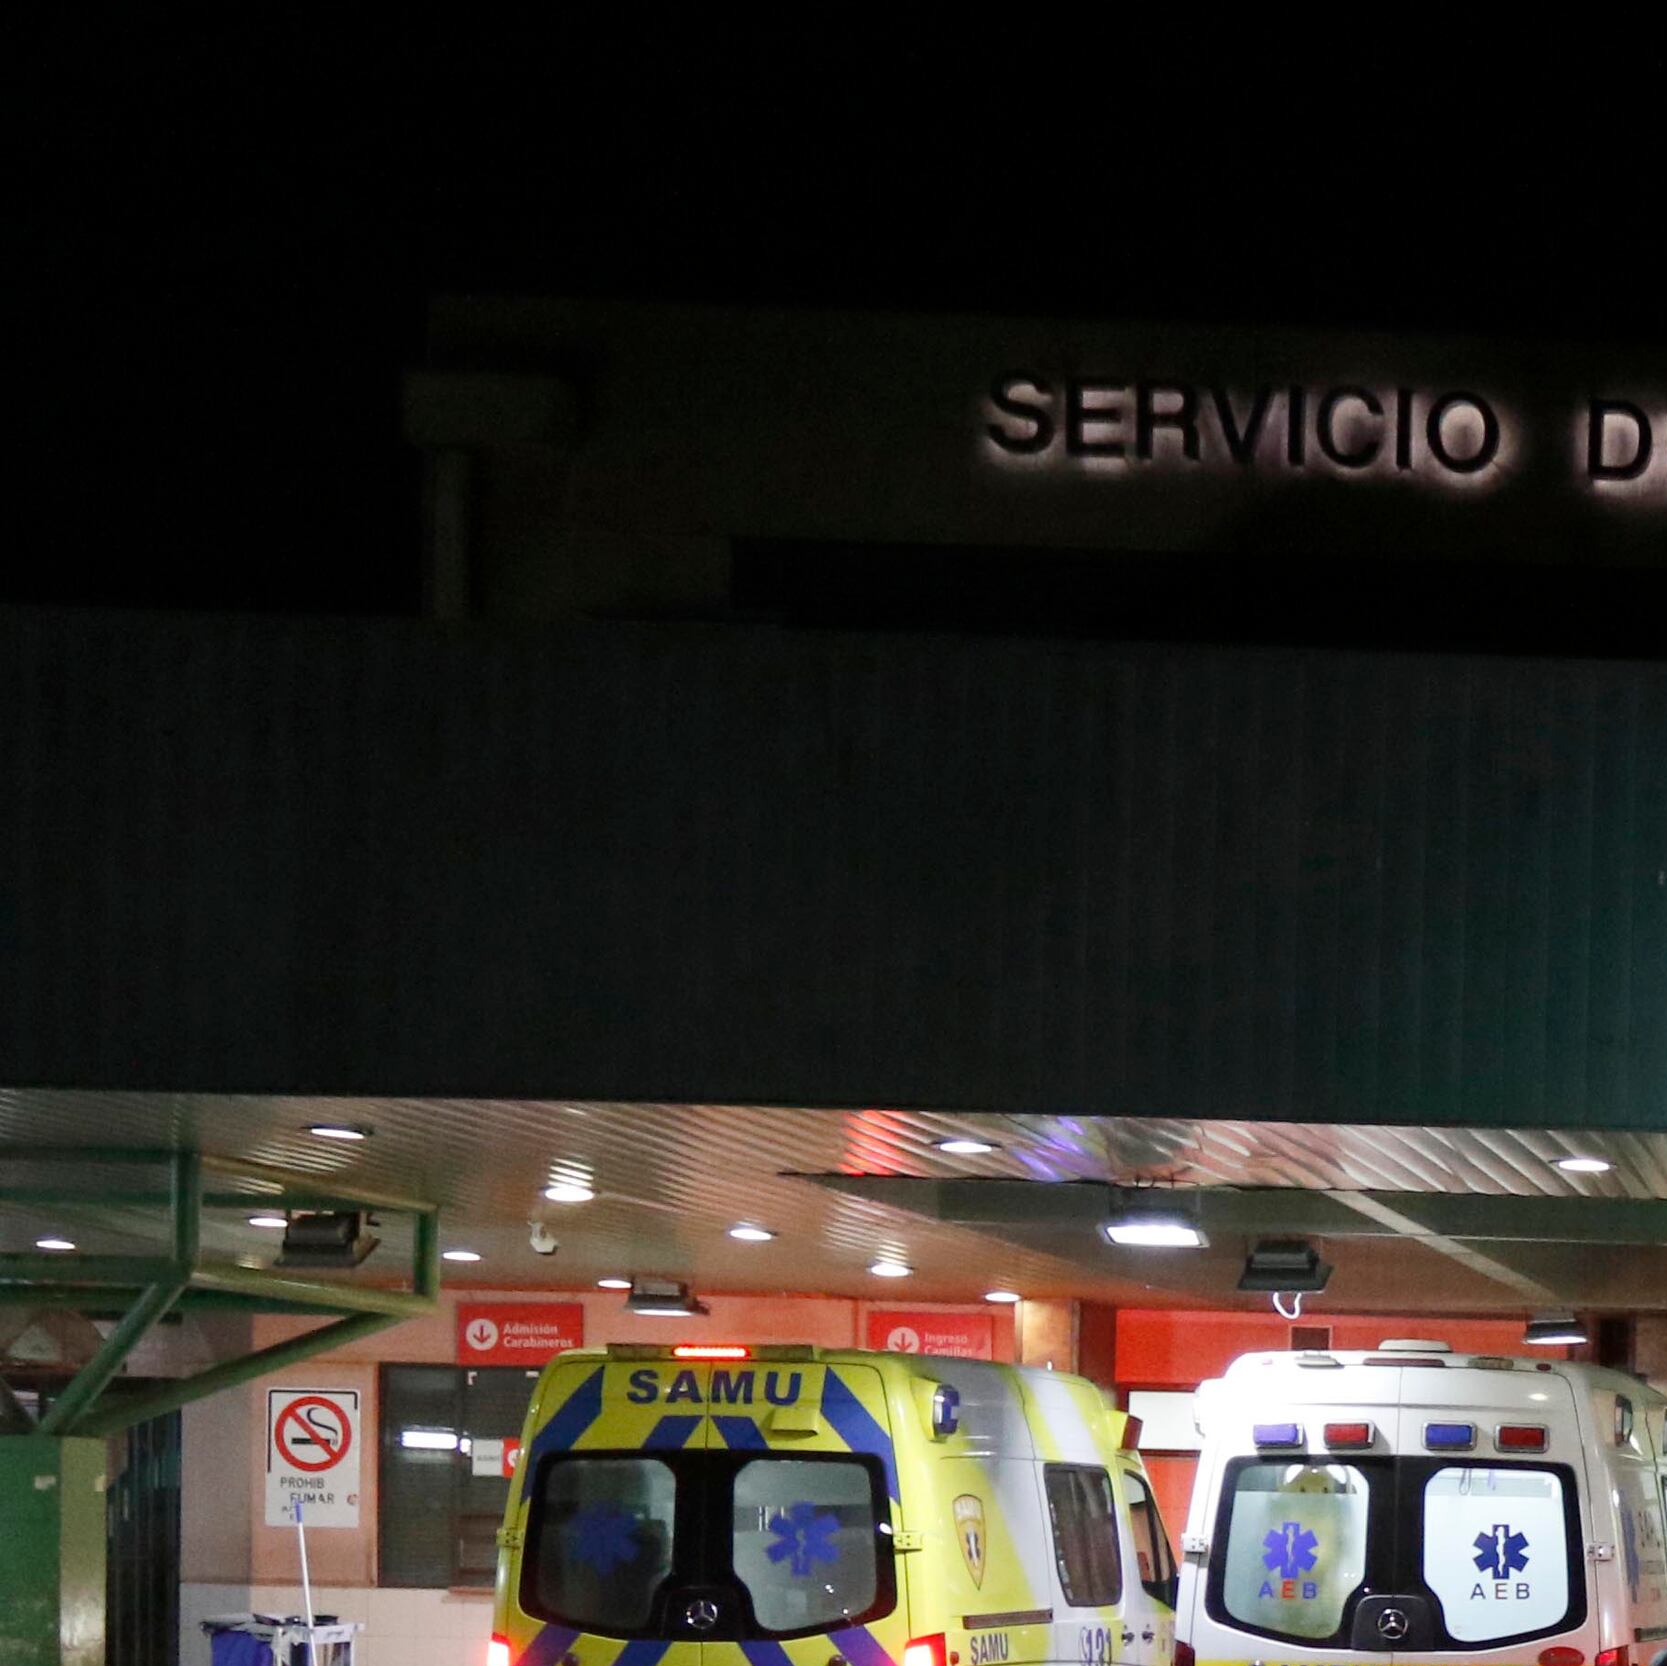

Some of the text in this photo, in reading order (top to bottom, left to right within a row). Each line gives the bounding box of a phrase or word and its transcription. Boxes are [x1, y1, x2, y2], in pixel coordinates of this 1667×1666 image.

[989, 368, 1500, 475] SERVICIO
[503, 1322, 558, 1336] Admisión
[924, 1332, 968, 1345] Ingreso
[503, 1336, 574, 1349] Carabineros
[627, 1369, 802, 1406] SAMU
[970, 1633, 1008, 1665] SAMU
